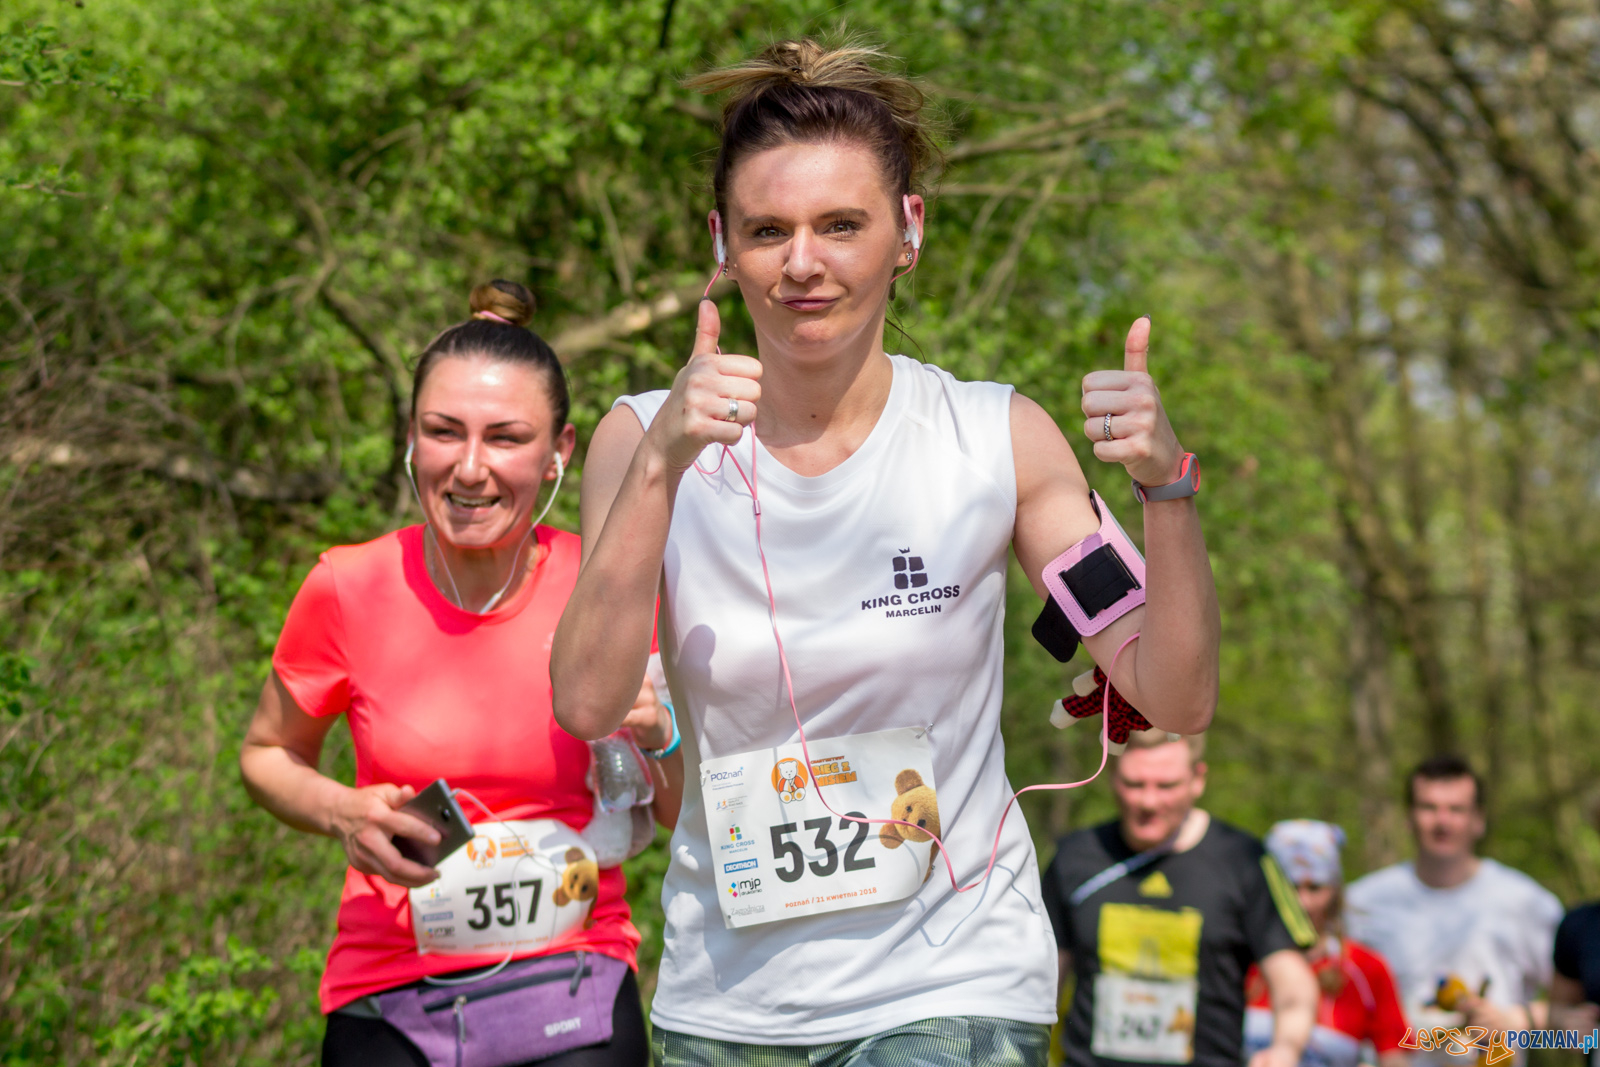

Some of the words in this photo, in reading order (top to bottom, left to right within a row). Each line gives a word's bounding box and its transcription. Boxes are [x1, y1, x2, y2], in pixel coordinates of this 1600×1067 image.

[862, 595, 902, 610] KING
[907, 585, 960, 604] CROSS
[886, 605, 942, 618] MARCELIN
[770, 812, 875, 882] 532
[726, 860, 756, 872] DECATHLON
[739, 877, 762, 890] mjp
[859, 887, 878, 896] 2018
[466, 878, 542, 930] 357
[543, 1016, 582, 1038] SPORT
